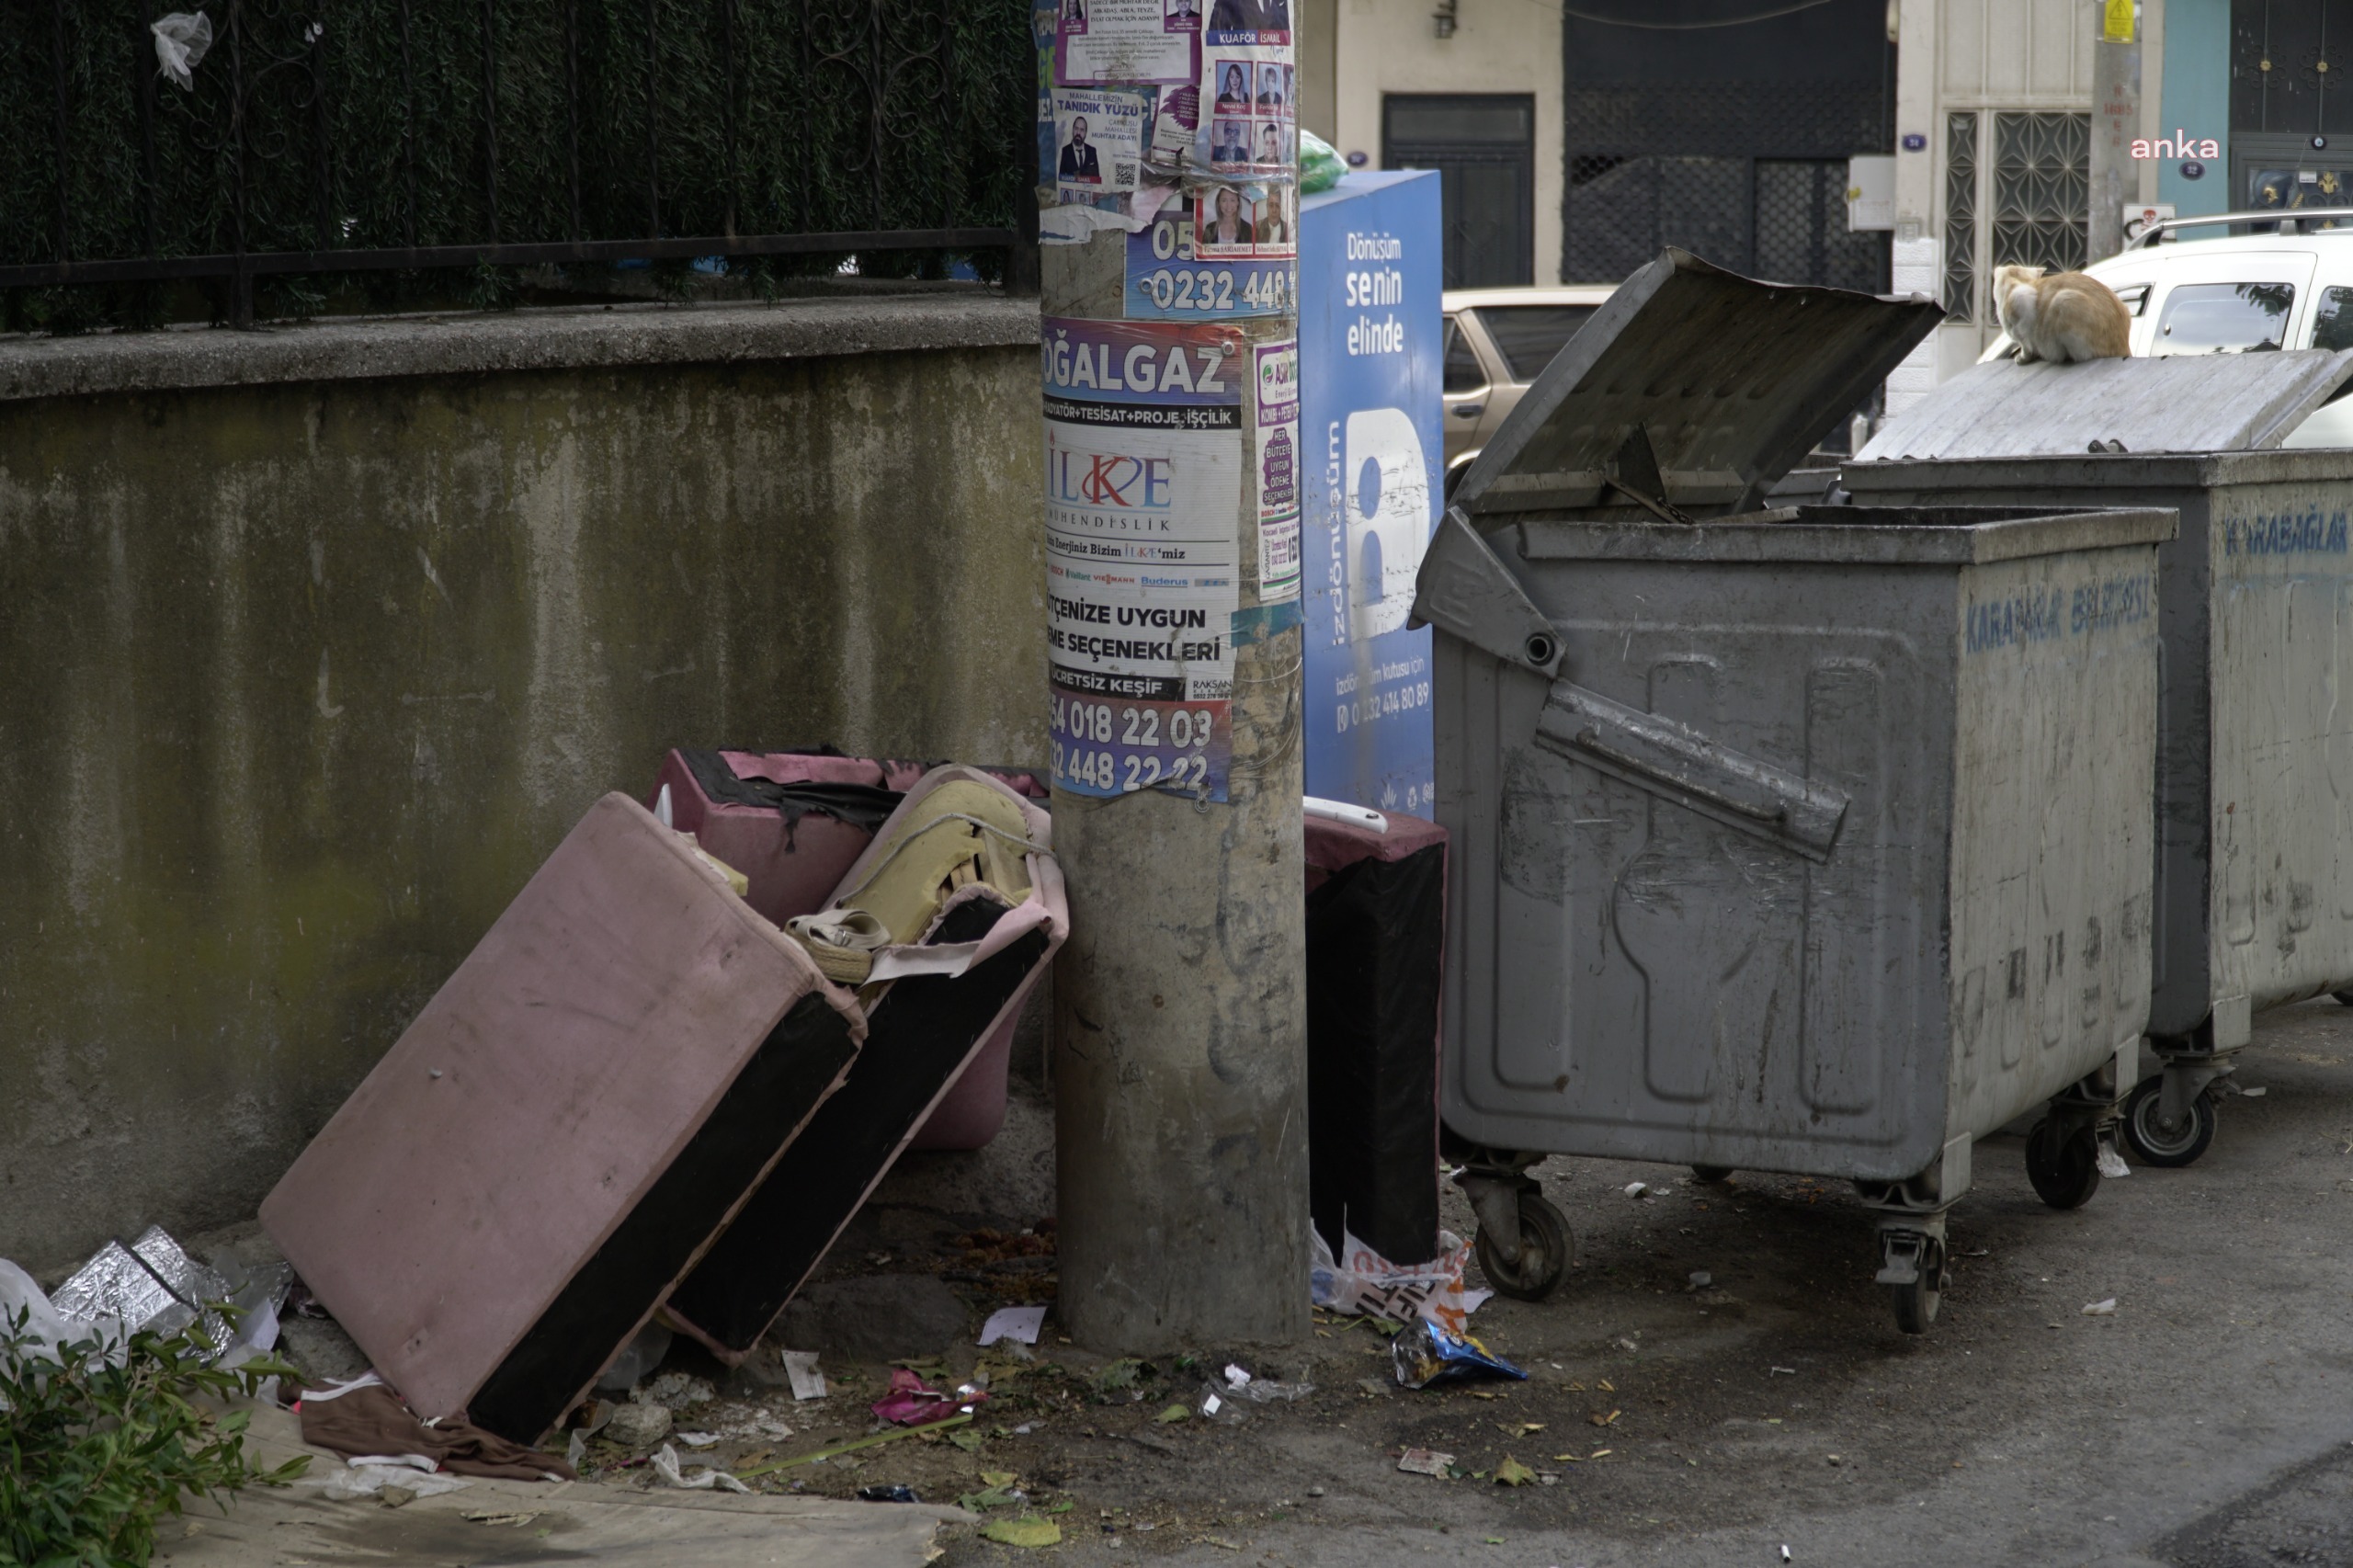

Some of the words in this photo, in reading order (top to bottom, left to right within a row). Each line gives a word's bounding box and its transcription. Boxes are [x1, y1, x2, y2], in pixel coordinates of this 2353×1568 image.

[1219, 31, 1256, 44] KUAFÖR
[1057, 99, 1101, 114] TANIDIK
[1105, 101, 1139, 117] YÜZÜ
[1069, 92, 1123, 103] MAHALLEMİZİN
[1347, 232, 1402, 264] Dönüşüm
[1151, 268, 1235, 311] 0232
[1243, 270, 1285, 310] 448
[1347, 266, 1402, 307] senin
[1347, 313, 1404, 356] elinde
[1274, 430, 1286, 441] HER
[1269, 460, 1290, 472] UYGUN
[1270, 475, 1290, 488] ÖDEME
[1055, 537, 1087, 554] Enerjiniz
[1090, 543, 1121, 557] Bizim
[1141, 576, 1188, 586] Buderus
[1117, 607, 1206, 628] UYGUN
[1068, 632, 1221, 662] SEÇENEKLERİ
[1382, 662, 1410, 681] kutusu
[1410, 654, 1425, 676] için
[1110, 678, 1163, 698] KEŞİF
[1383, 691, 1400, 715] 414
[1402, 687, 1415, 710] 80
[1416, 682, 1429, 707] 89
[1070, 700, 1113, 744] 018
[1121, 707, 1160, 747] 22
[1169, 710, 1212, 748] 03
[1068, 747, 1115, 790] 448
[1122, 754, 1162, 792] 22
